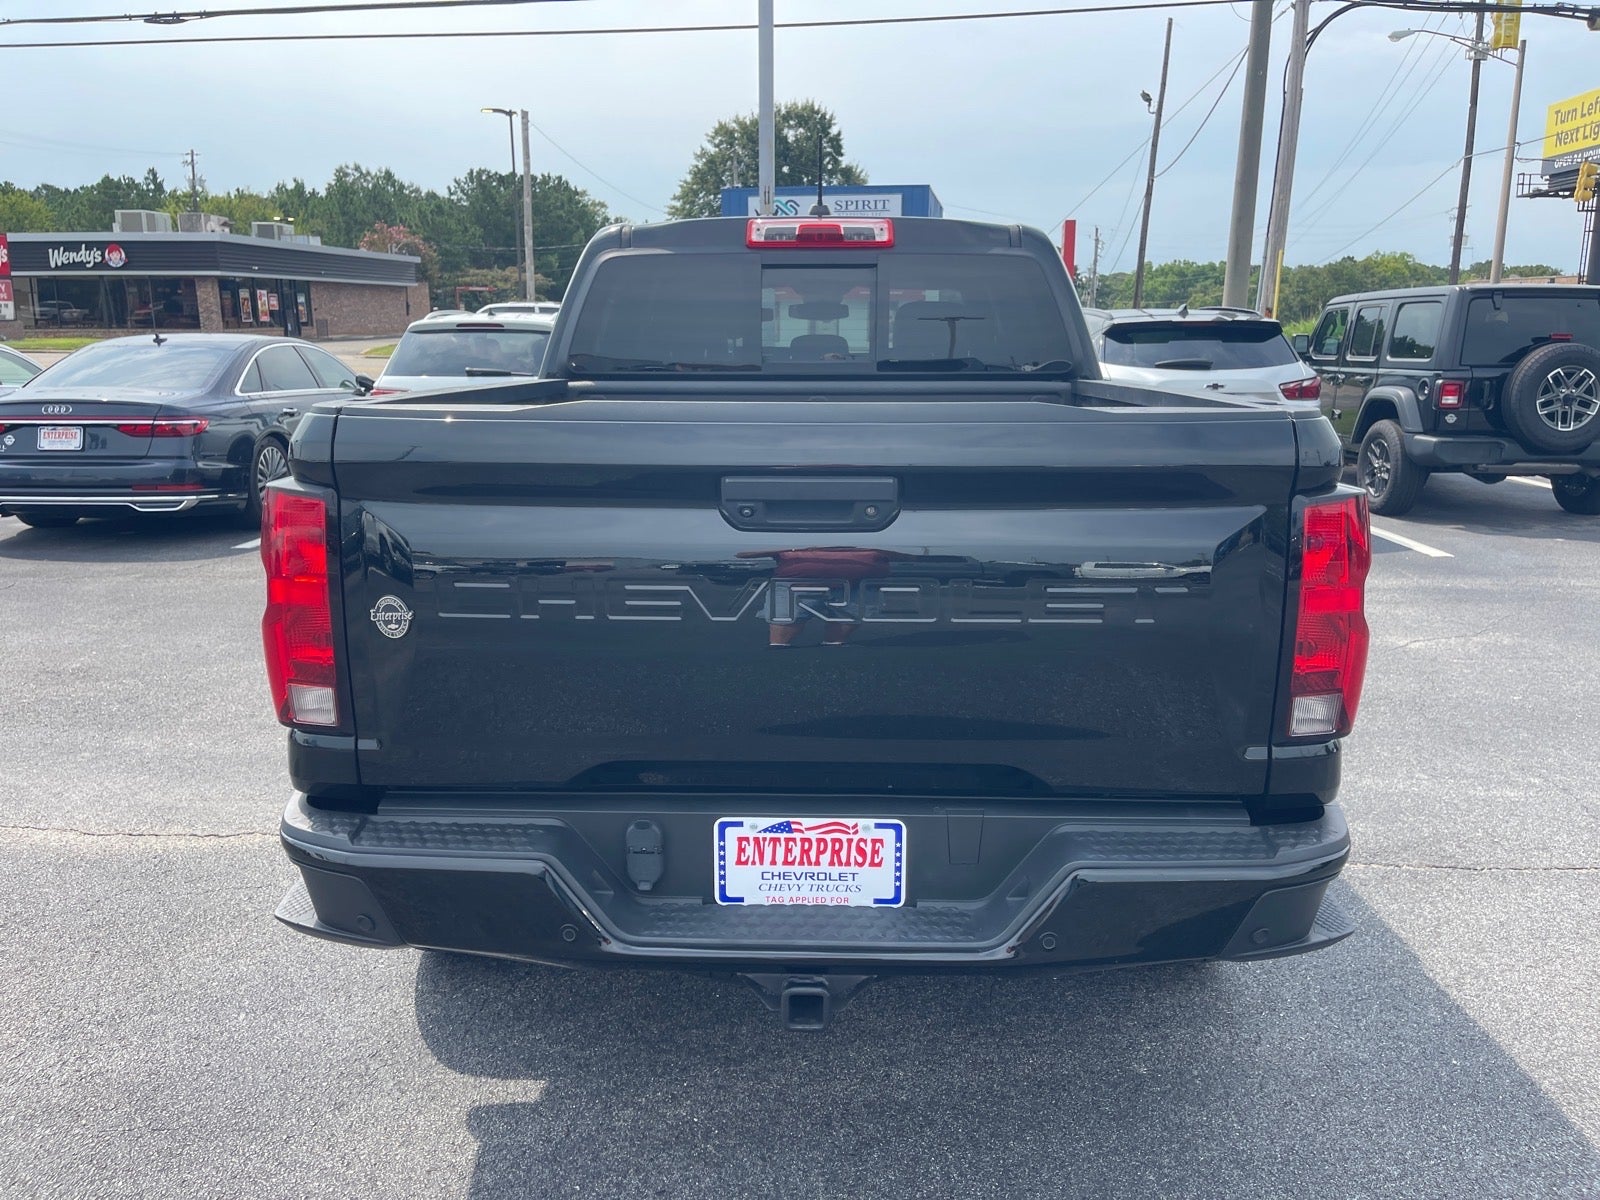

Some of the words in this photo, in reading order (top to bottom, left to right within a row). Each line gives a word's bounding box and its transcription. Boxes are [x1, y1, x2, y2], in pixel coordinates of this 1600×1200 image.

[1554, 108, 1578, 126] Turn
[1555, 127, 1580, 148] Next
[1554, 155, 1572, 168] OPEN
[834, 199, 890, 211] SPIRIT
[48, 243, 103, 269] Wendy's
[43, 431, 78, 440] ENTERPRISE
[437, 578, 1189, 623] CHEVROLET
[370, 609, 414, 624] Enterprise
[735, 836, 885, 868] ENTERPRISE
[761, 871, 859, 882] CHEVROLET
[758, 882, 804, 892] CHEVY
[808, 883, 862, 893] TRUCKS
[765, 896, 785, 904] TAG
[788, 896, 827, 904] APPLIED
